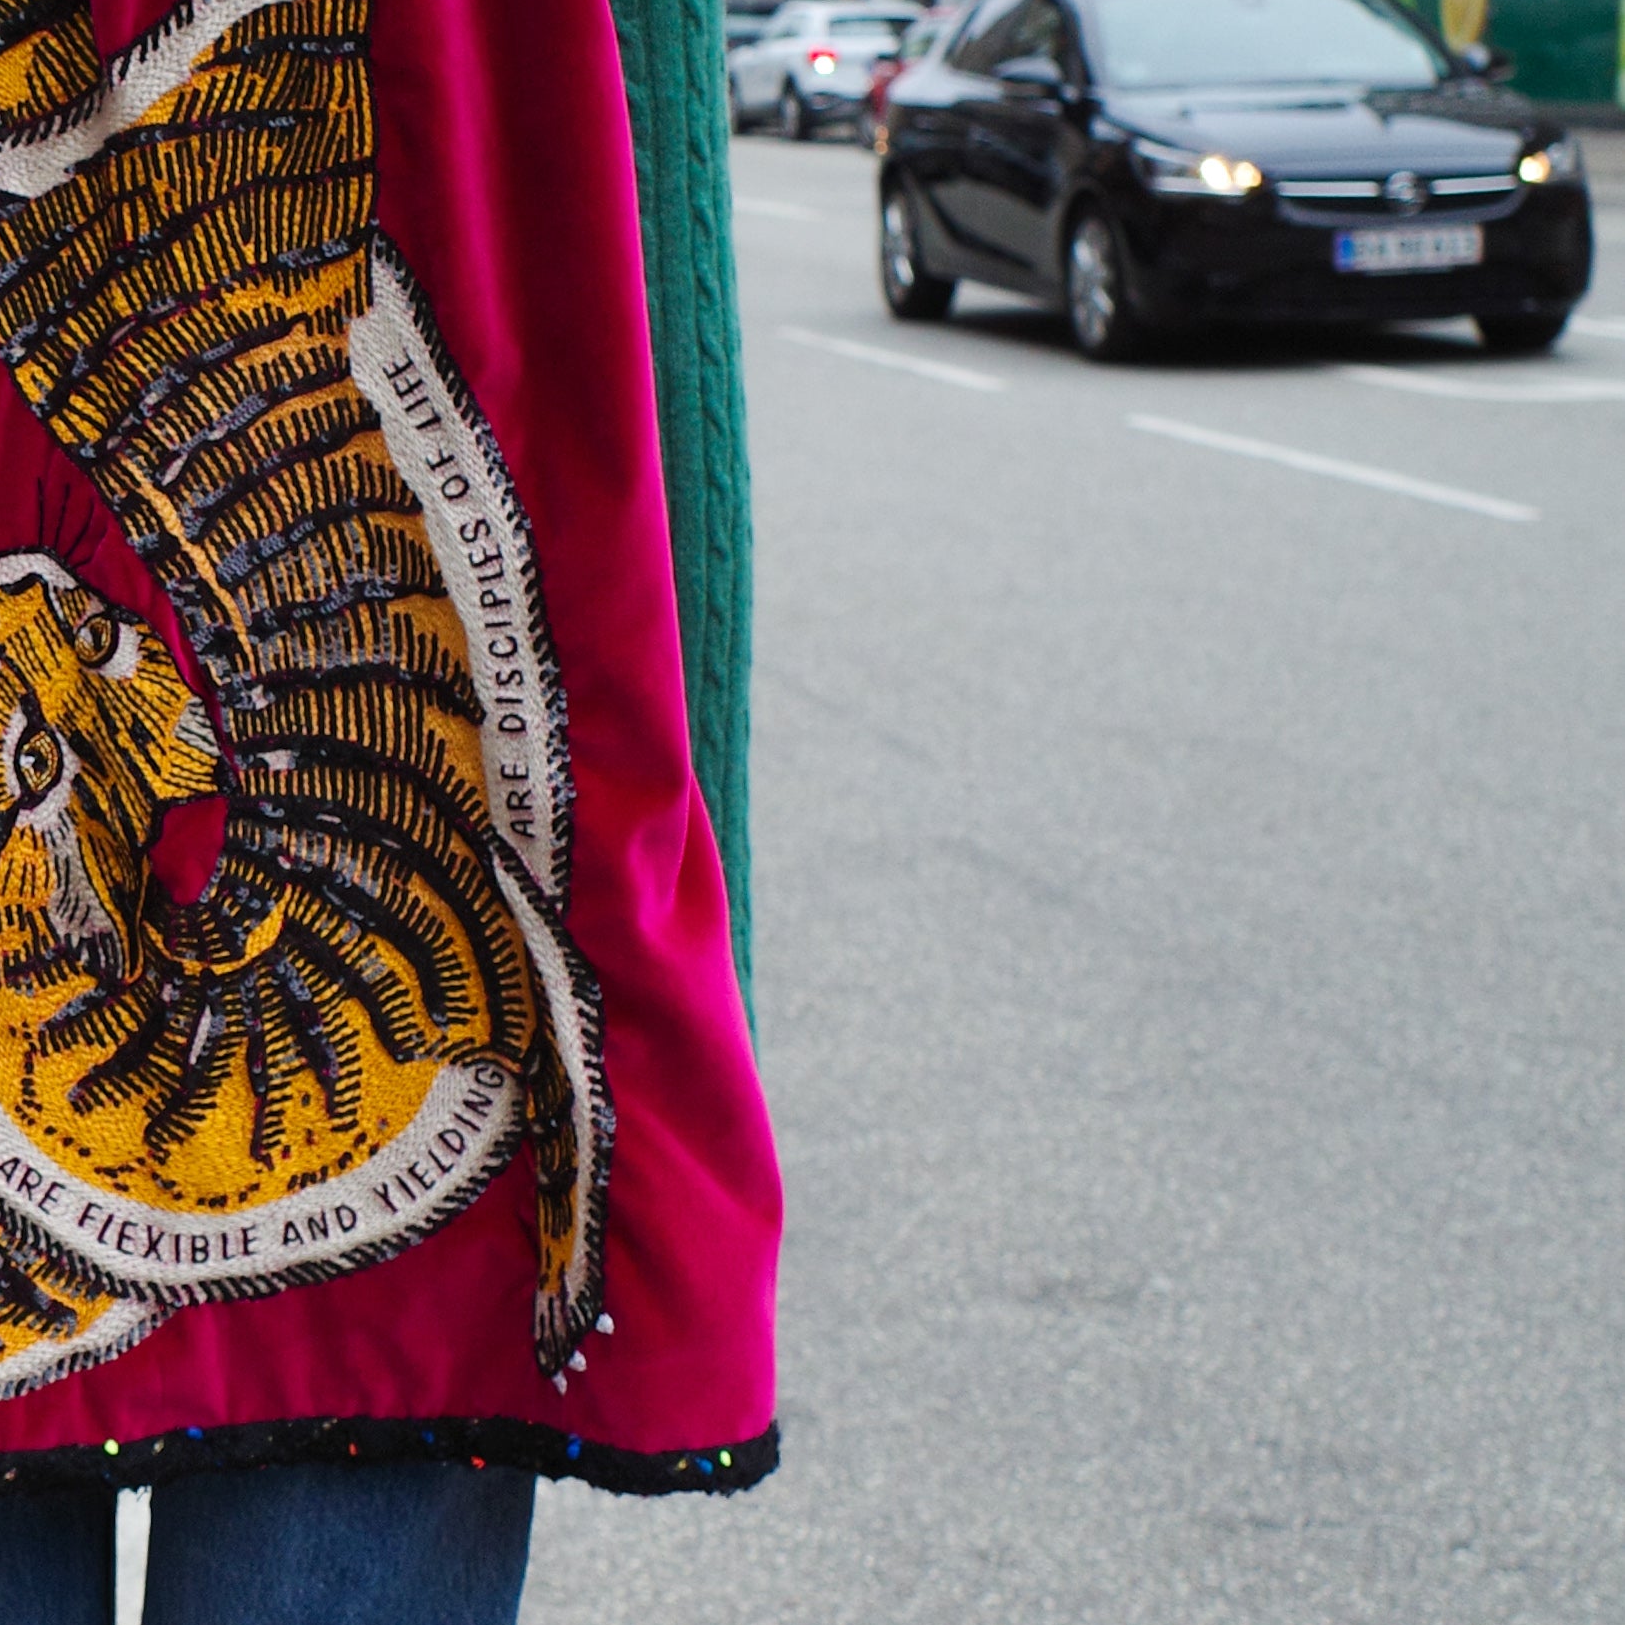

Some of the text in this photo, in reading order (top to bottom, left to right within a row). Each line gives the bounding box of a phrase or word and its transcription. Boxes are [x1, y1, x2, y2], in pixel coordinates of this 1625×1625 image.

[382, 351, 538, 839] ARE DISCIPLES OF LIFE
[76, 1201, 260, 1265] FLEXIBLE
[281, 1203, 358, 1247] AND
[373, 1064, 506, 1216] YIELDING
